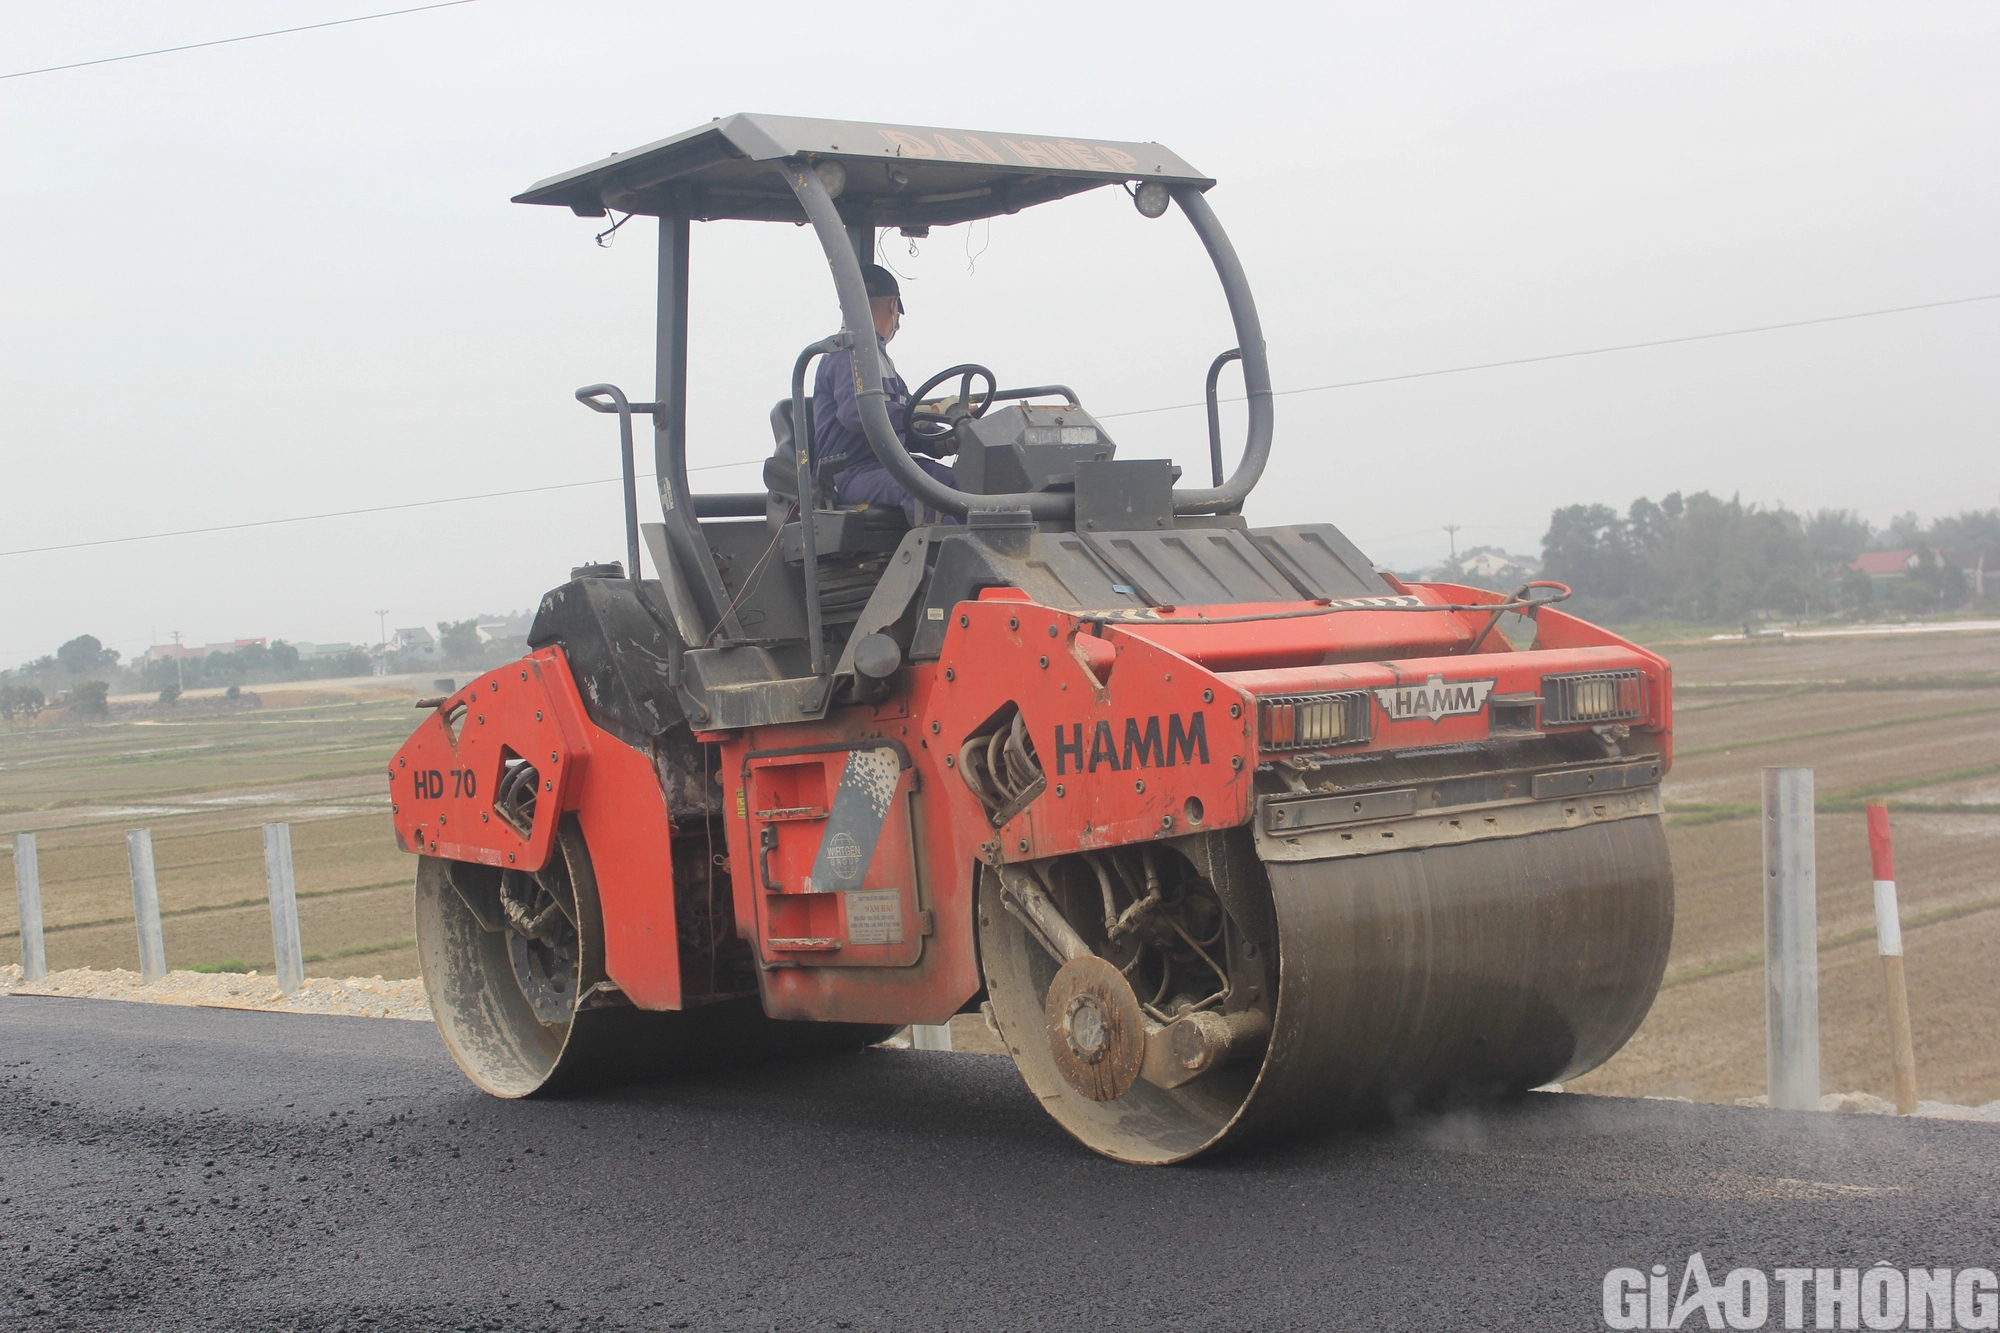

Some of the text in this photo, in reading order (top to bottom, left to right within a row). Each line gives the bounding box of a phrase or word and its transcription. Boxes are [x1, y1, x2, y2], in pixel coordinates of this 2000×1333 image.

[1395, 686, 1476, 716] HAMM
[1054, 711, 1211, 776] HAMM
[413, 769, 477, 800] HD 70
[826, 845, 861, 857] WIRTGEN
[830, 857, 860, 867] GROUP
